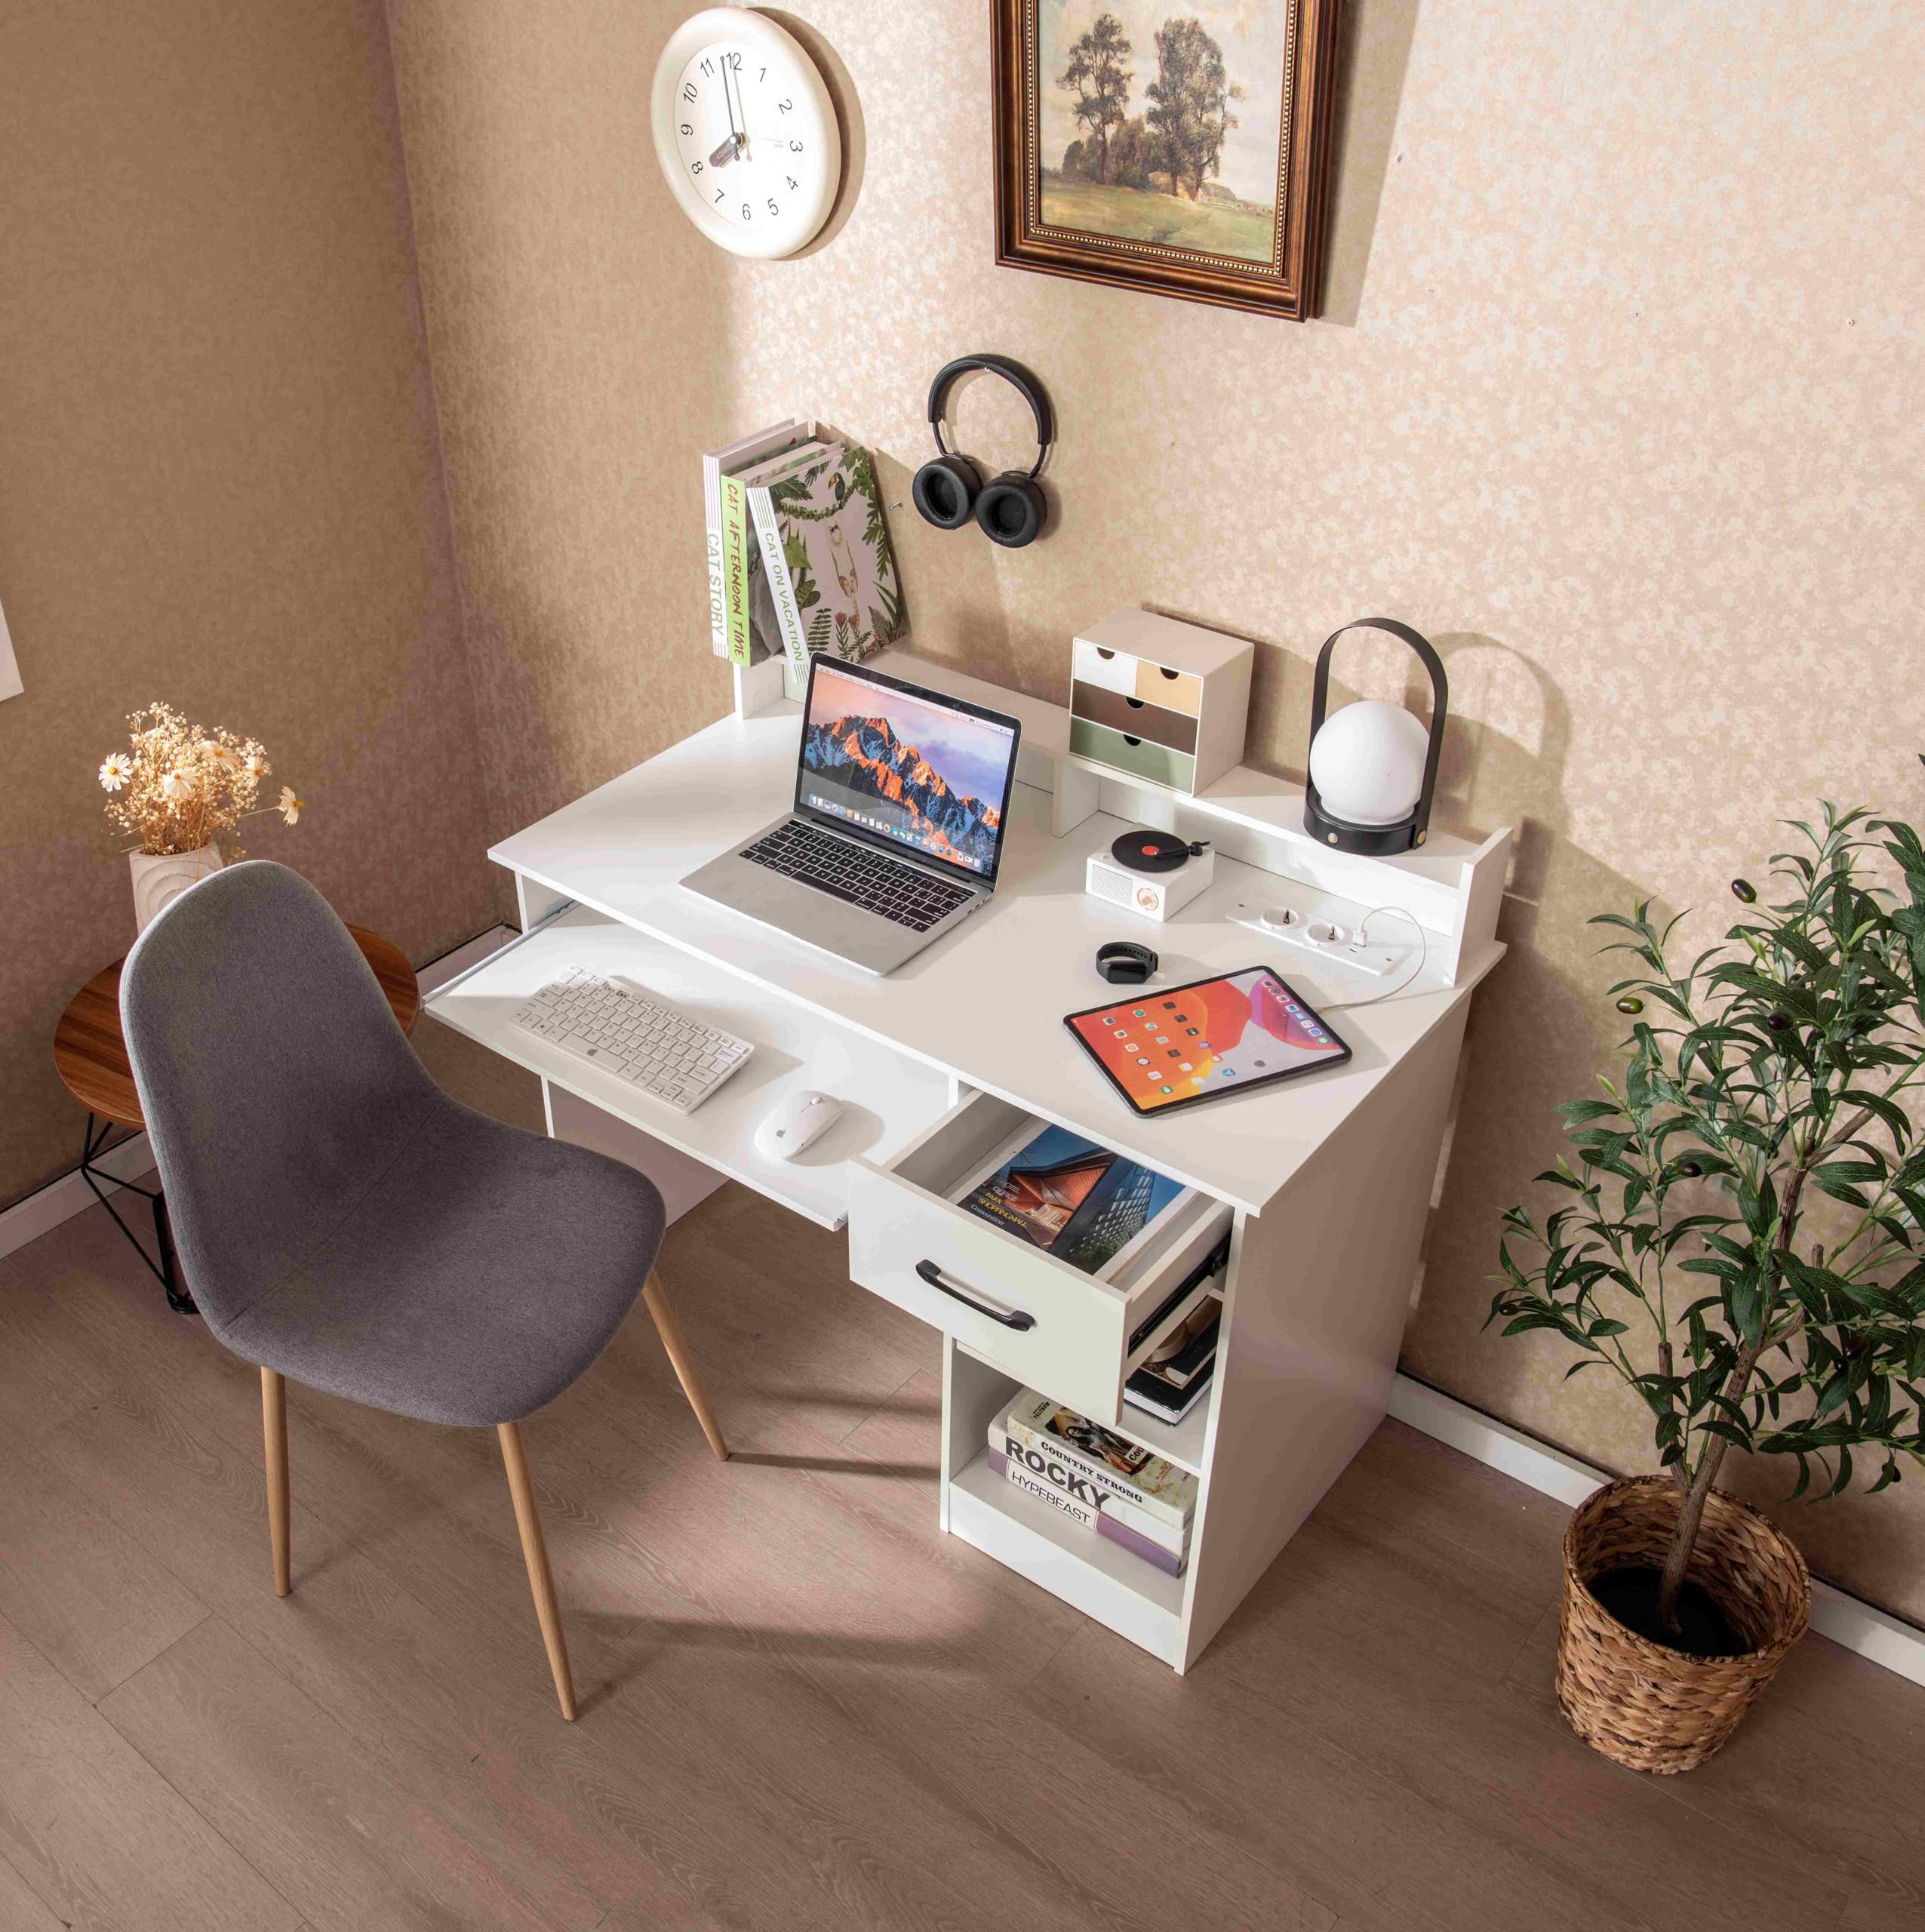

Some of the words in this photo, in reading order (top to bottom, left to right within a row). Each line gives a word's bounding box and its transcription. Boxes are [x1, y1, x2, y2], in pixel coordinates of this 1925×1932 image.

[700, 57, 715, 78] 11
[726, 52, 743, 71] 12
[760, 67, 767, 83] 1
[683, 83, 698, 103] 10
[779, 99, 792, 115] 2
[681, 124, 693, 136] 9
[789, 140, 803, 152] 3
[691, 161, 703, 174] 8
[786, 176, 798, 190] 4
[715, 189, 724, 203] 7
[743, 204, 751, 220] 6
[767, 198, 779, 216] 5
[727, 484, 739, 516] CAT
[708, 534, 720, 571] CAT
[729, 520, 743, 615] AFTERNOON
[709, 574, 724, 636] STORY
[766, 532, 779, 561] CAT
[773, 565, 785, 586] ON
[780, 589, 804, 662] VACATION
[733, 620, 745, 659] TIME
[992, 1186, 1019, 1202] OFFICE
[1000, 1180, 1020, 1194] HOTEL
[986, 1192, 1003, 1204] PARK
[971, 1204, 1004, 1226] Convention
[1005, 1435, 1111, 1511] ROCKY
[1041, 1441, 1094, 1476] COUNTRY
[1096, 1472, 1143, 1504] STRONG
[1012, 1471, 1090, 1524] HYPEBEAST
